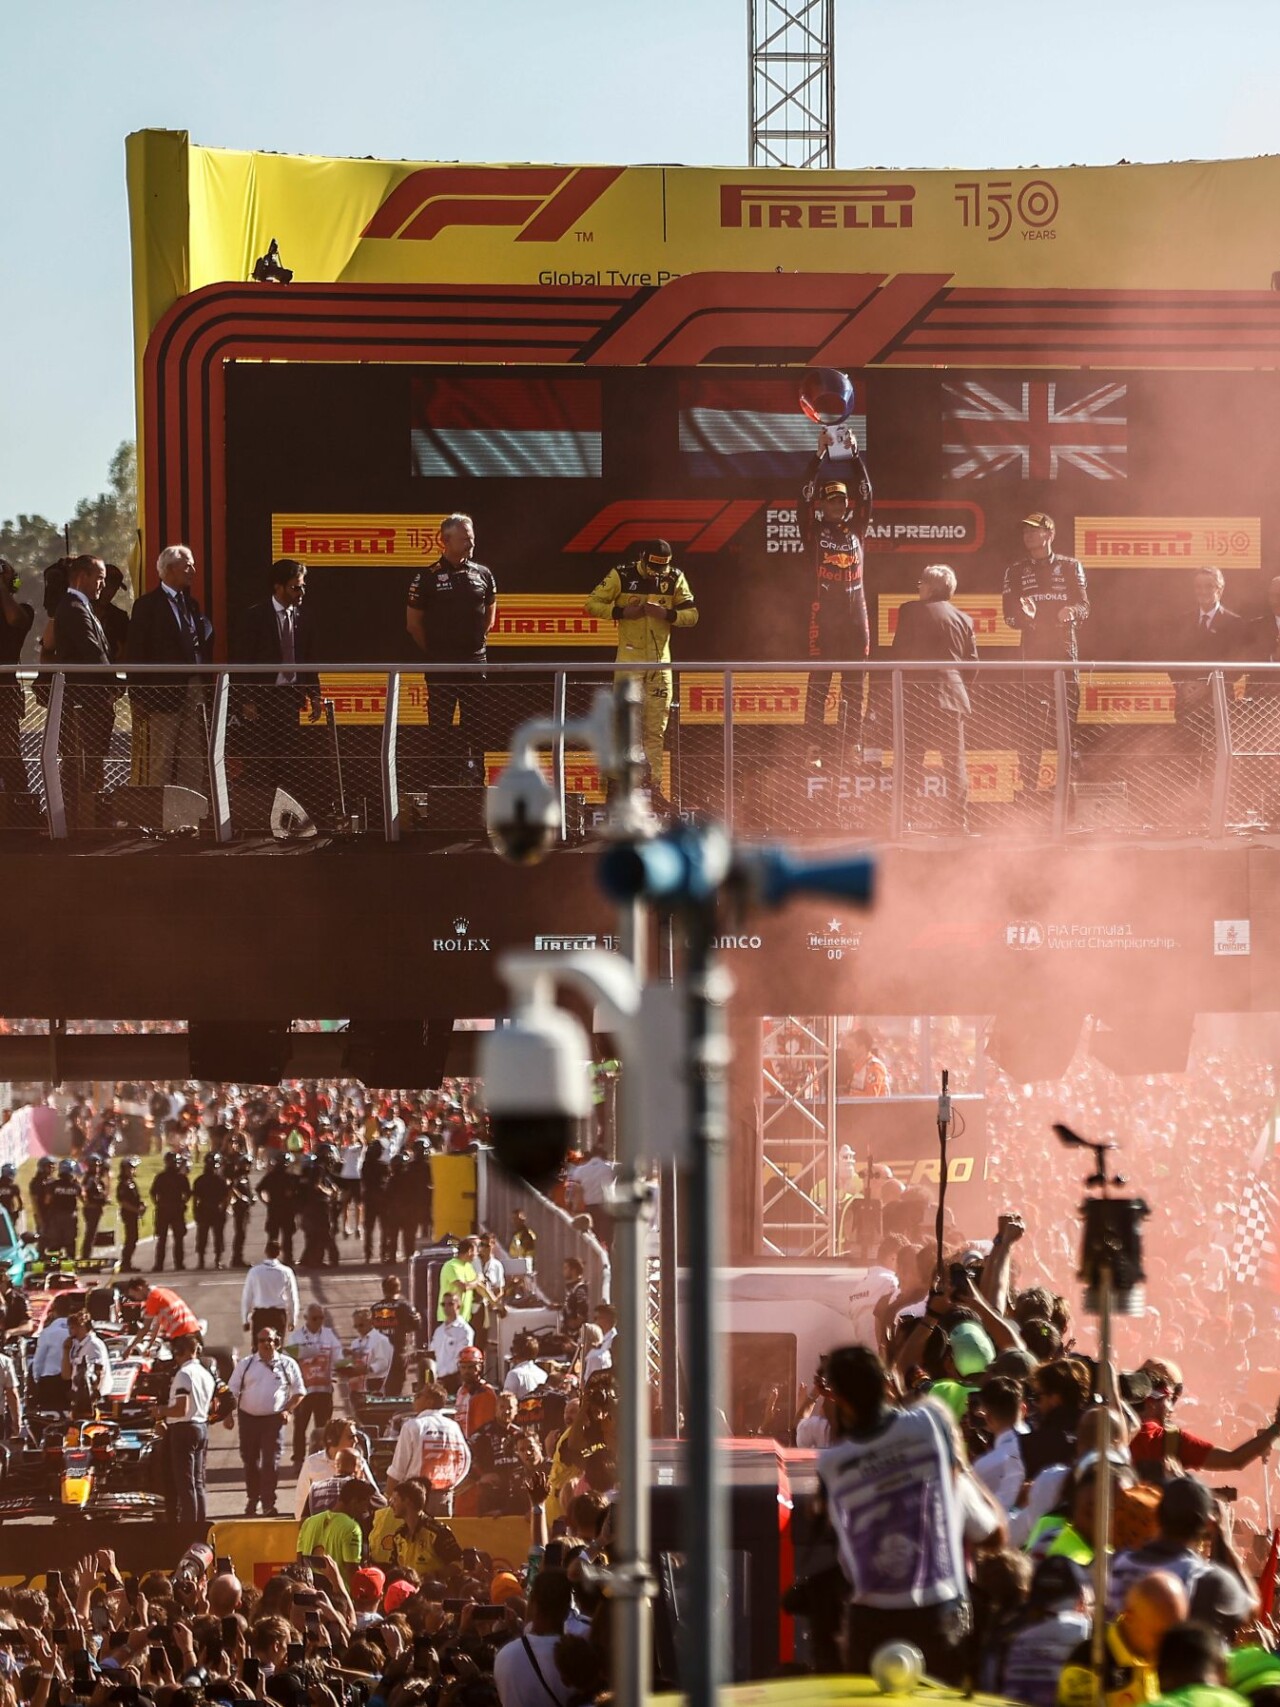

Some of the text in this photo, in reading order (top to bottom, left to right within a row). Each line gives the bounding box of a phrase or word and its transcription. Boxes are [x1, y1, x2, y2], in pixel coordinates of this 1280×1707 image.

[720, 185, 916, 228] PIRELLI
[955, 180, 1059, 242] 150
[1021, 230, 1056, 241] YEARS
[538, 271, 600, 286] Global
[606, 271, 651, 286] Tyre
[894, 525, 966, 538] PREMIO
[282, 528, 396, 554] PIRELLI
[1084, 530, 1193, 556] PIRELLI
[1048, 925, 1069, 936] FIA
[433, 939, 490, 951] ROLEX
[535, 936, 596, 950] PIRELLI
[810, 936, 859, 946] Heineken
[1048, 938, 1087, 949] World
